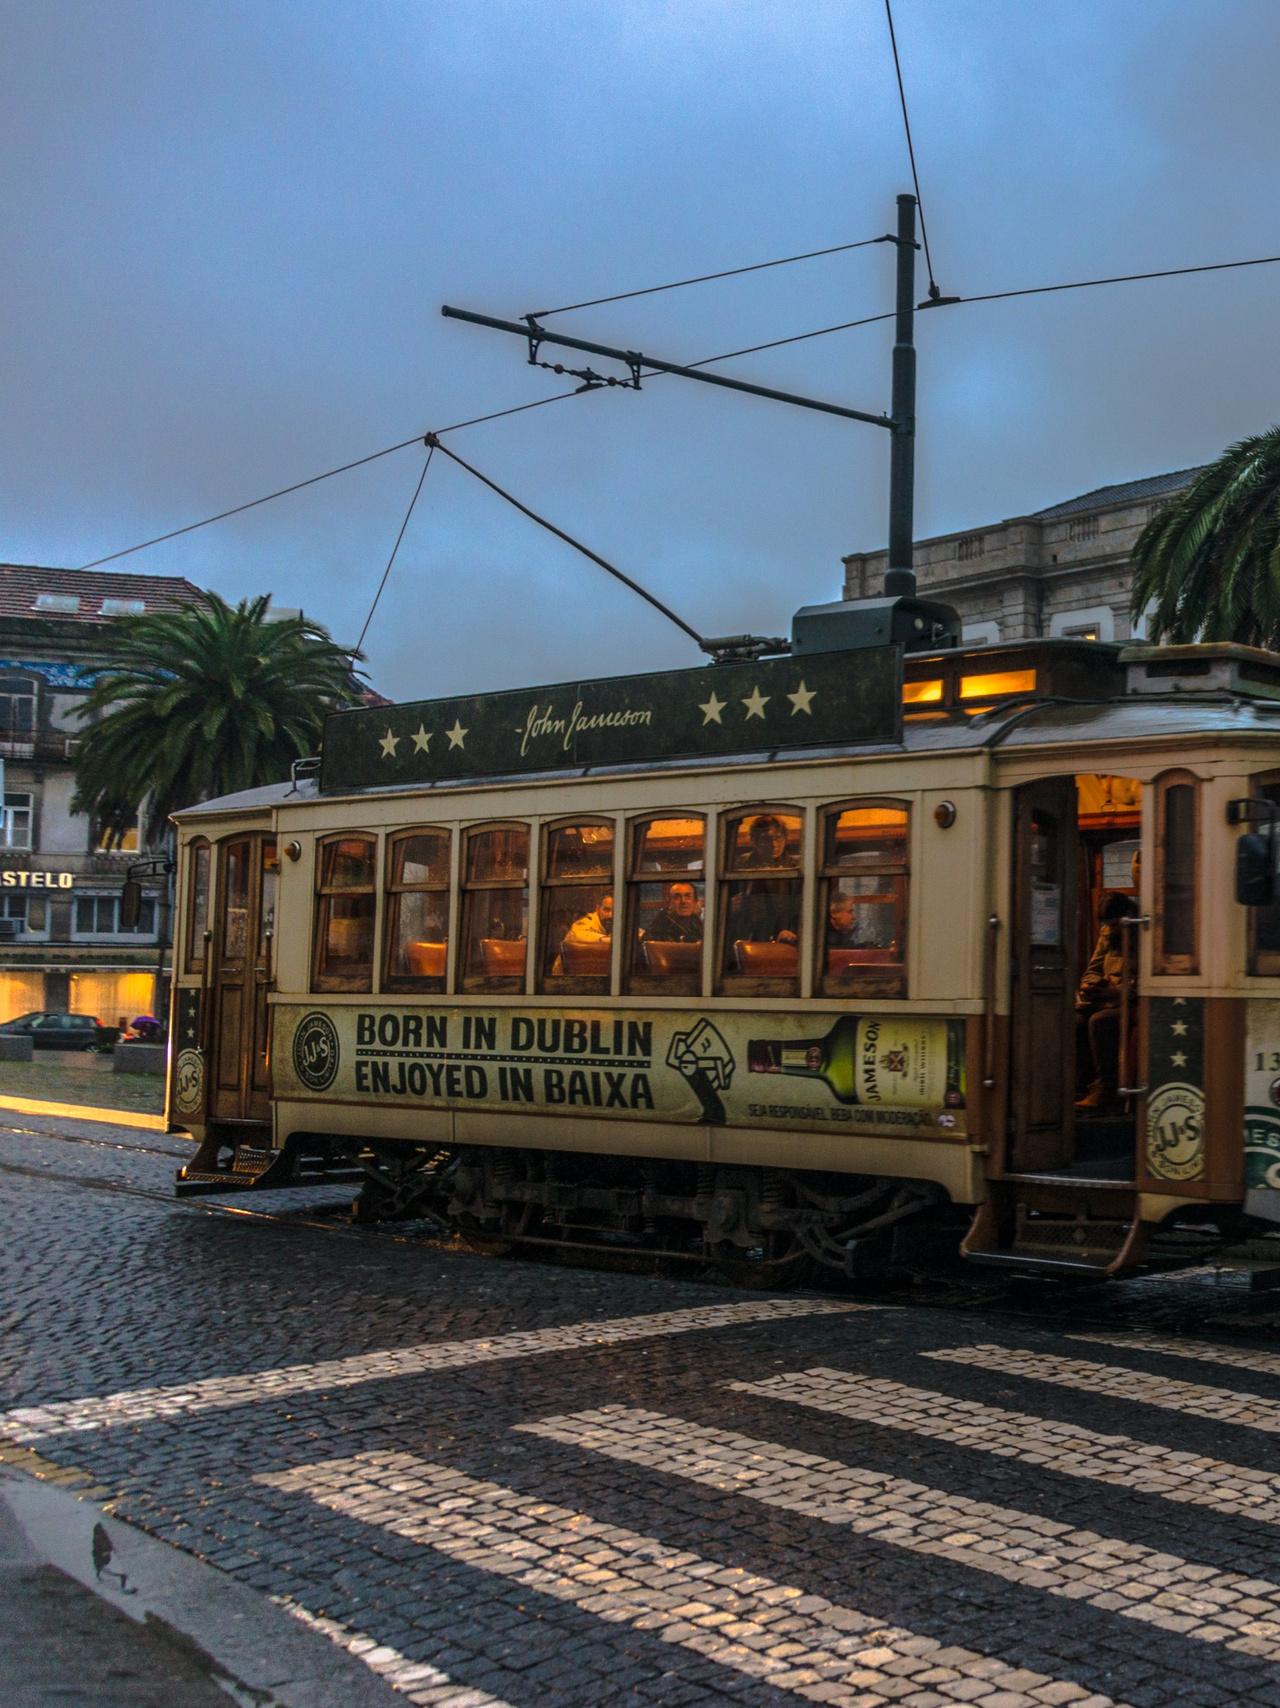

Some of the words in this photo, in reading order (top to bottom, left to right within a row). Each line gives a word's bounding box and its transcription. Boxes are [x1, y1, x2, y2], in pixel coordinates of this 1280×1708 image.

[564, 701, 651, 750] Jameson
[0, 871, 74, 889] STELO
[356, 1013, 447, 1049] BORN
[461, 1016, 497, 1051] IN
[511, 1017, 652, 1057] DUBLIN
[355, 1060, 488, 1099] ENJOYED
[498, 1066, 535, 1102] IN
[544, 1068, 655, 1110] BAIXA
[862, 1021, 882, 1101] JAMESON
